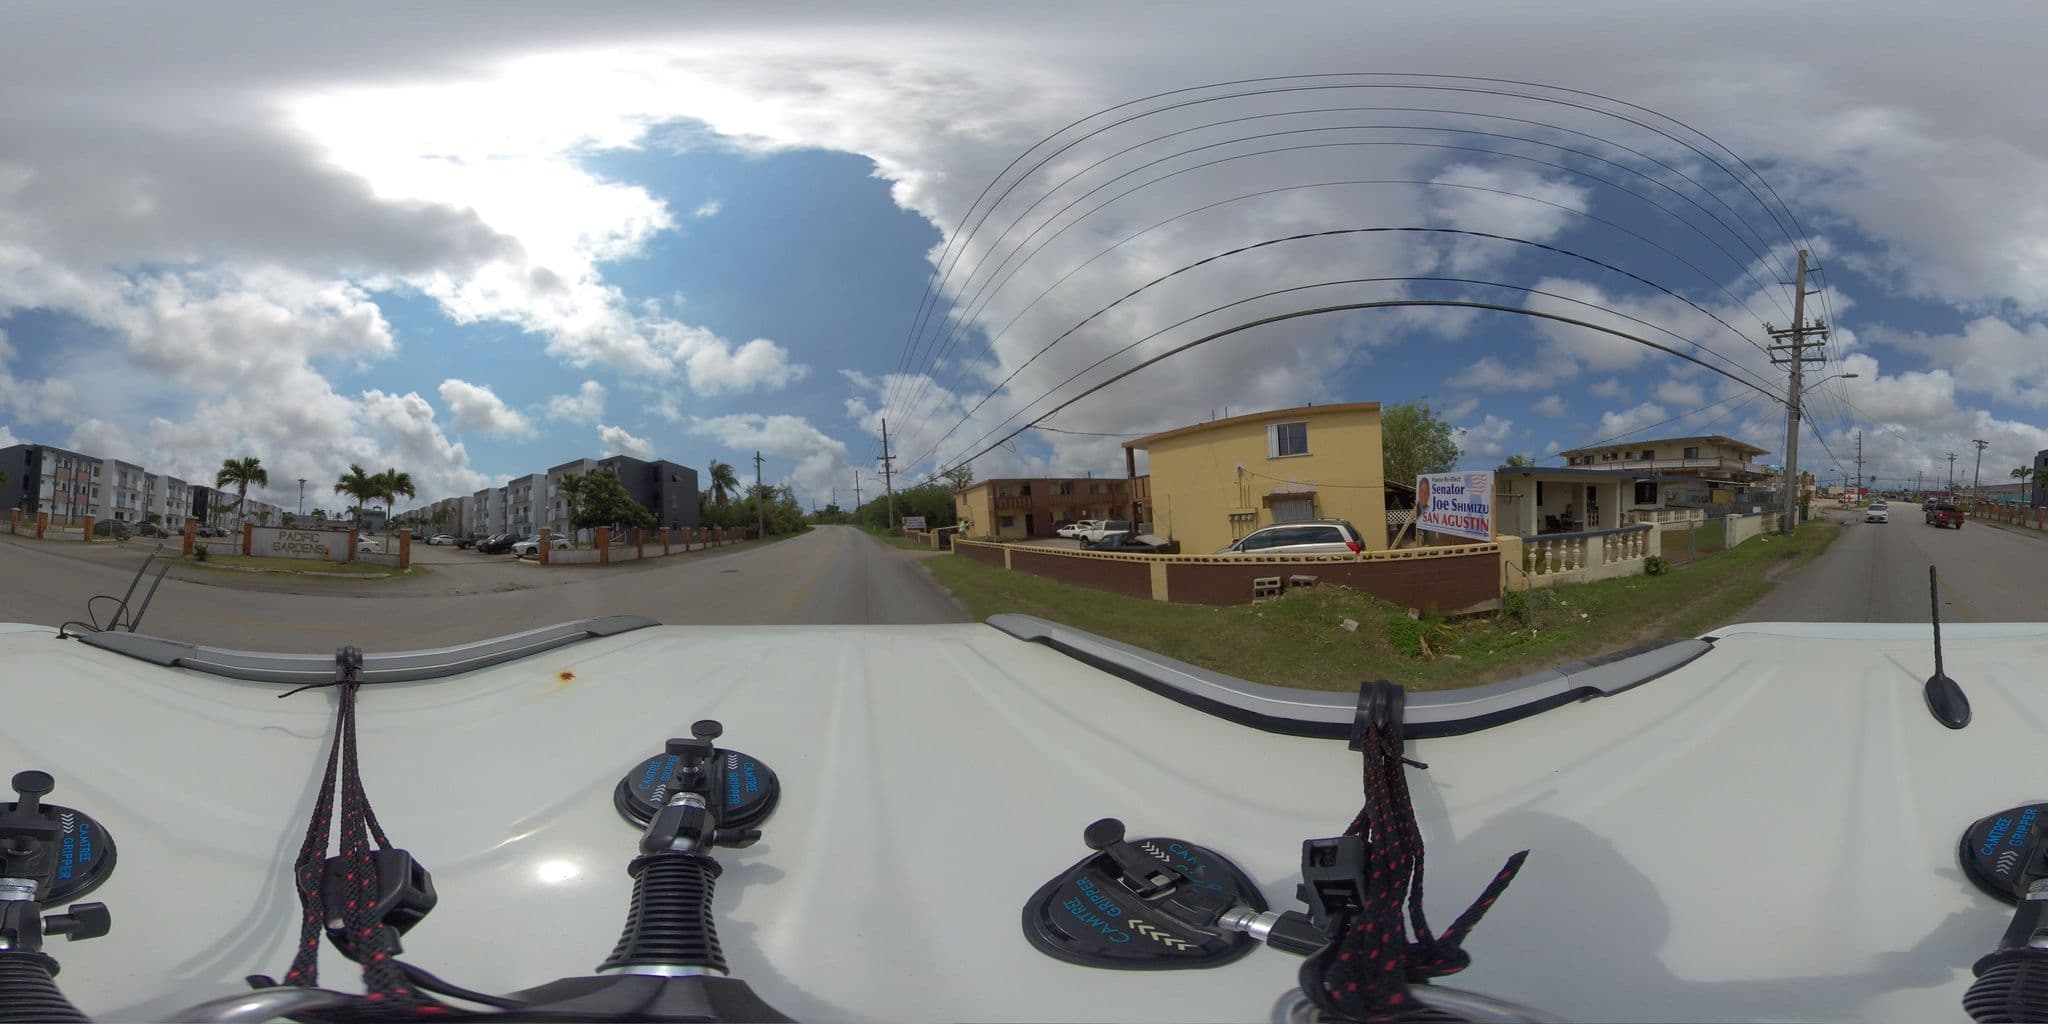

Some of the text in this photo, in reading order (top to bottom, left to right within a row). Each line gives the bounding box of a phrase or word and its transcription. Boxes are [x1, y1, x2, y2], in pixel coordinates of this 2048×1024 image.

[1432, 484, 1465, 495] Senator
[1432, 496, 1489, 514] Joe SHIMIZU
[278, 531, 321, 543] PACIFIC
[1423, 511, 1489, 531] SAN AGUSTIN
[272, 542, 324, 553] GARDENS
[727, 772, 741, 806] GRIPPER
[743, 762, 758, 793] CAMTREE
[79, 823, 91, 863] CAMTREE
[1981, 817, 2012, 856] CAMTREE
[2009, 807, 2038, 848] GRIPPER
[60, 837, 74, 880] GRIPPER
[1074, 876, 1122, 918] GRIPPER
[1063, 897, 1131, 944] CAMTREE
